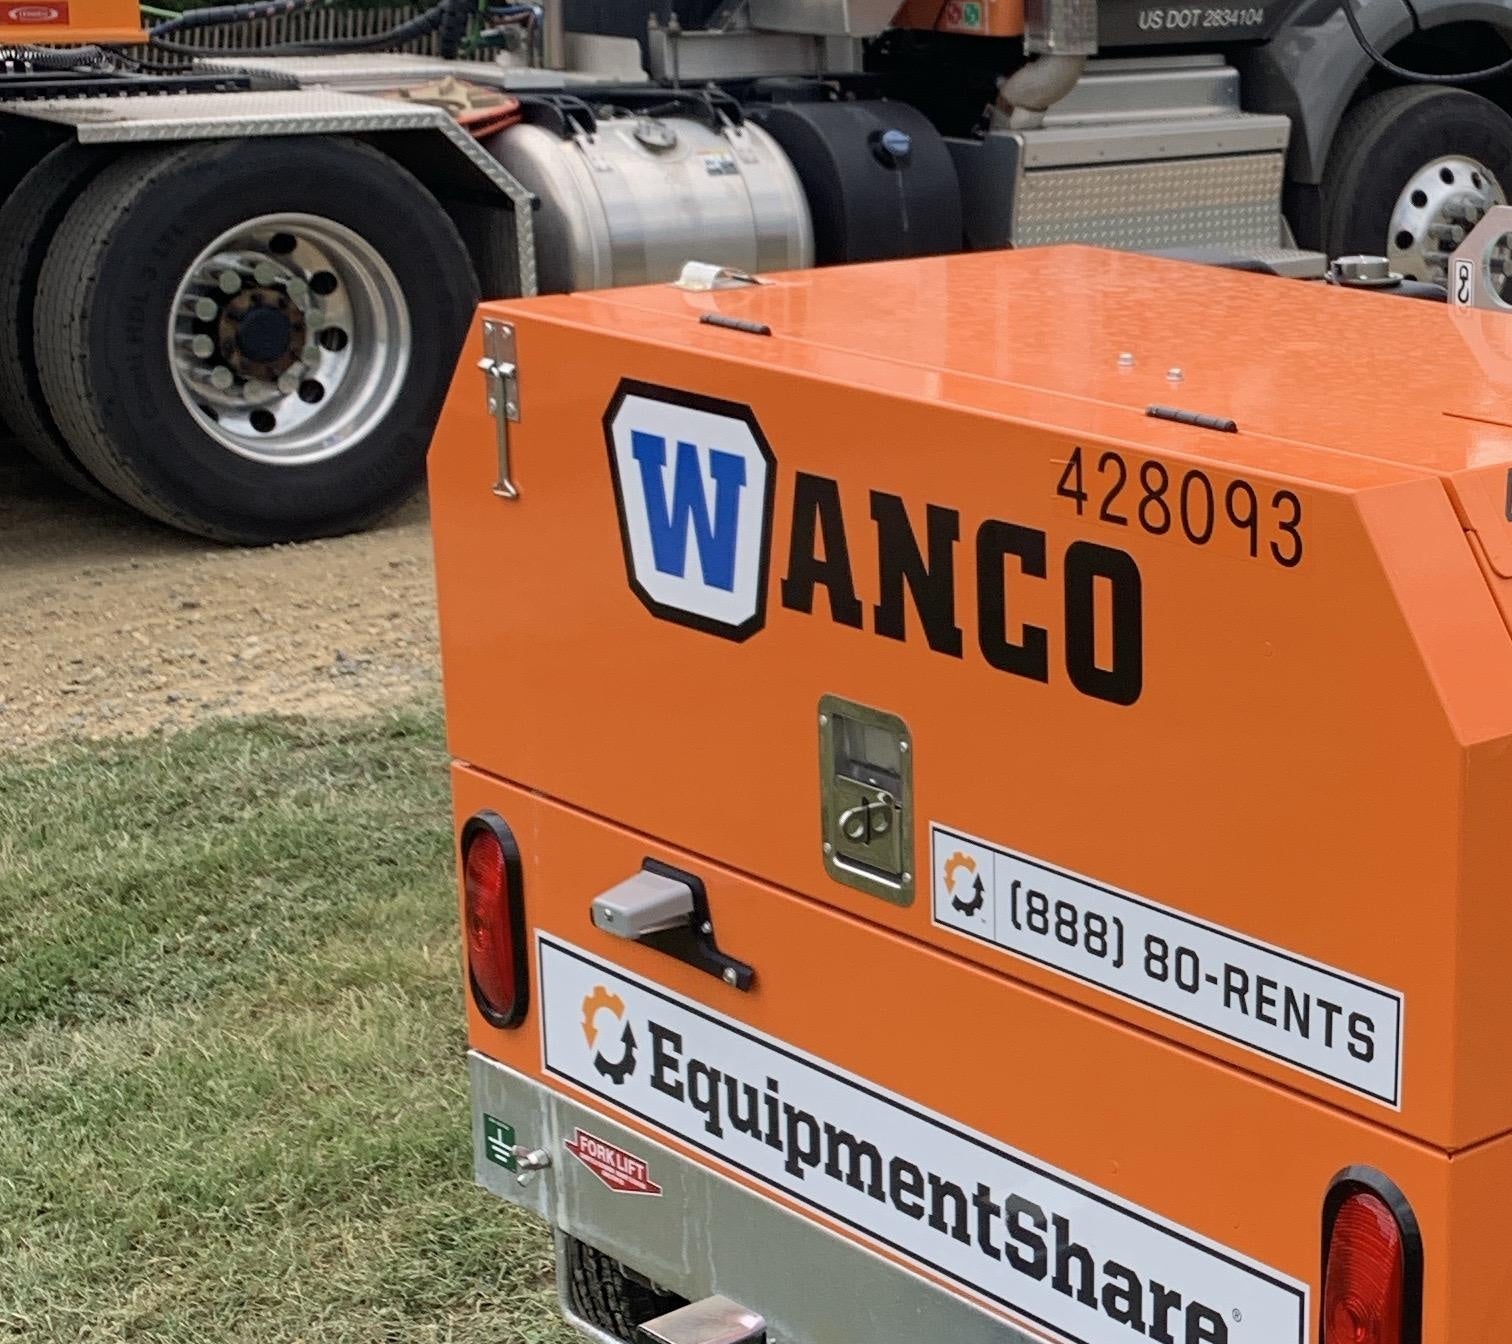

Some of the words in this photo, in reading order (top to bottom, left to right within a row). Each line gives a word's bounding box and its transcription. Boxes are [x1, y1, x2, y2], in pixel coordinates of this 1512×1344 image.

[1139, 10, 1164, 30] US
[1166, 9, 1200, 28] DOT
[630, 428, 1143, 707] WANCO
[1055, 445, 1304, 569] 428093
[1009, 878, 1125, 969] (888)
[1143, 933, 1377, 1065] 80-RENTS
[579, 1135, 617, 1166] FORK
[616, 1153, 645, 1181] LIFT
